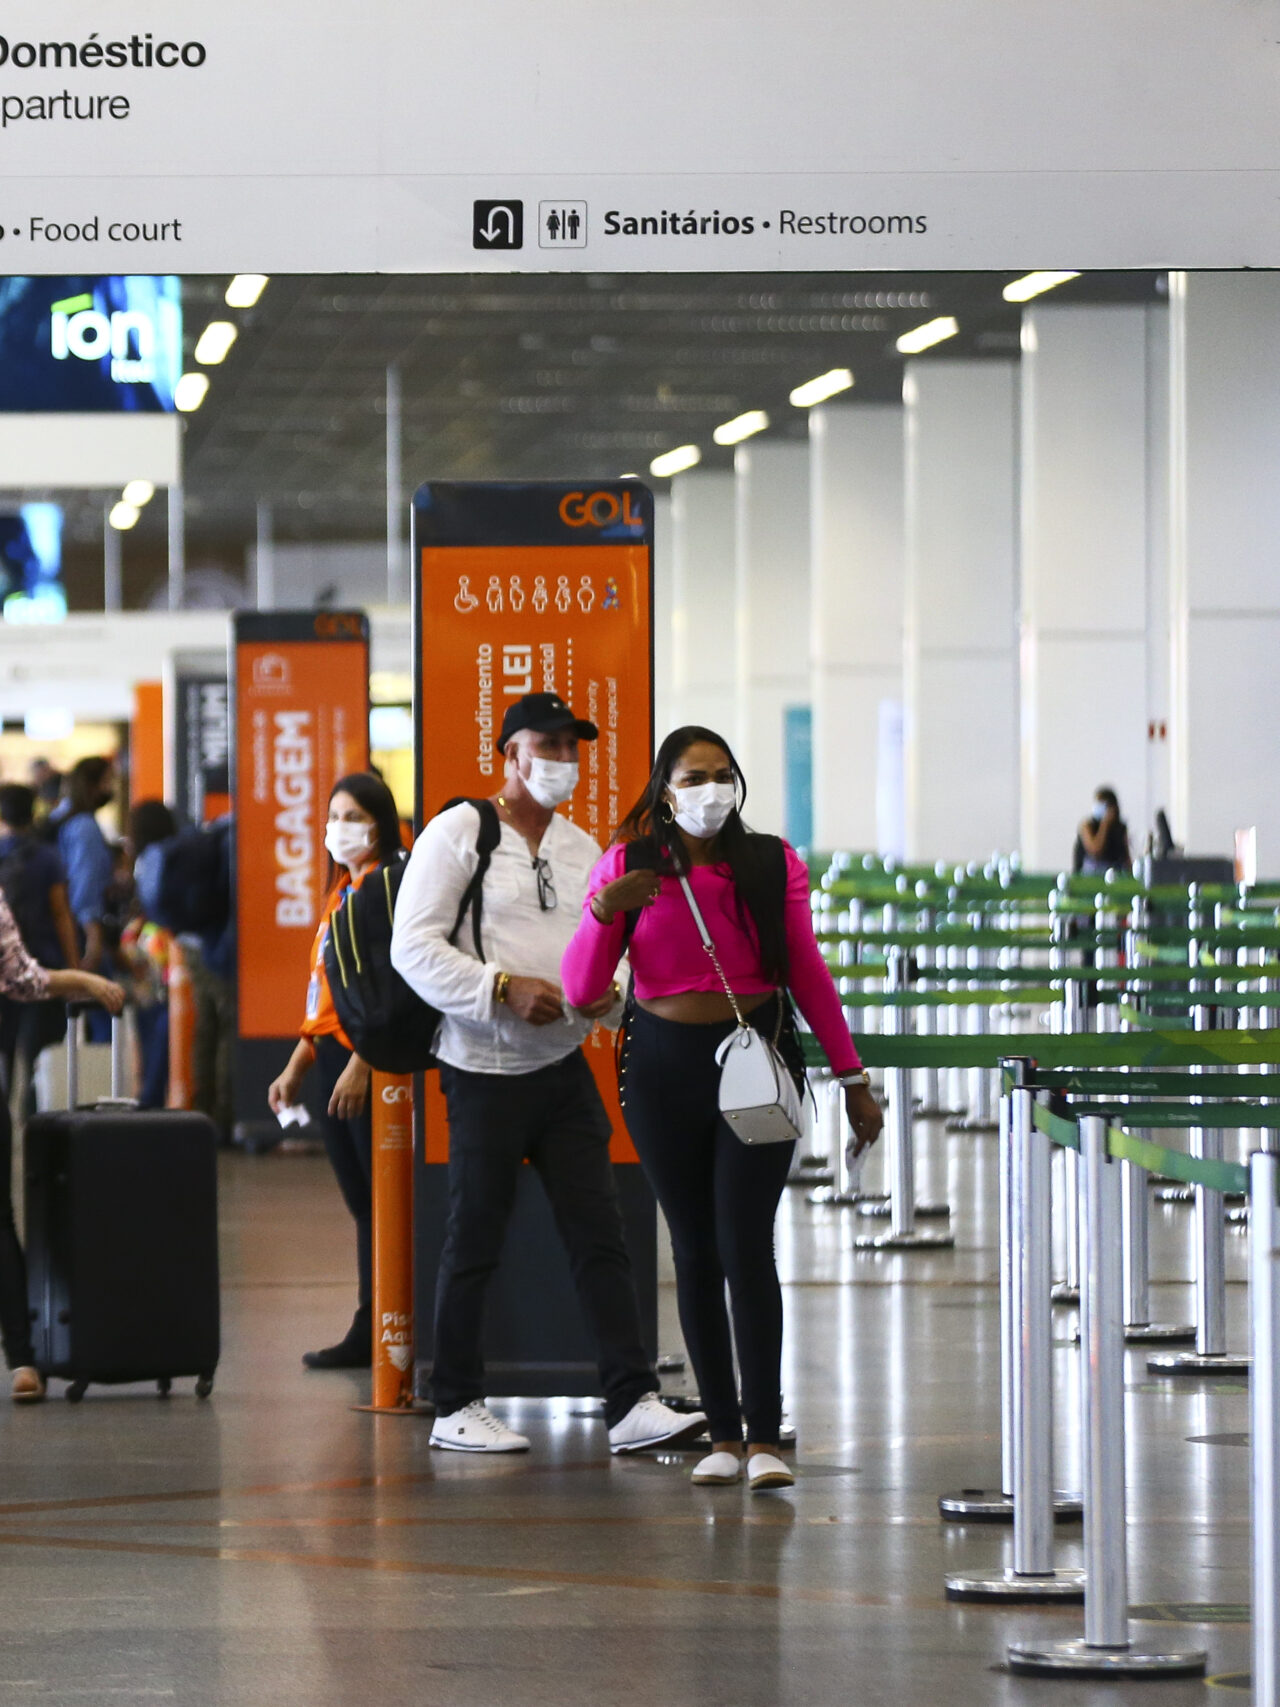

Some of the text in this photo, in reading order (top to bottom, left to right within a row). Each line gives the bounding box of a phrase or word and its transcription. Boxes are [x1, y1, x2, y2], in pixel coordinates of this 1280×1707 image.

[28, 217, 100, 242] Food
[107, 219, 183, 242] court
[604, 208, 928, 236] Sanitários Restrooms
[558, 491, 642, 527] GOL
[502, 644, 532, 694] LEI
[540, 643, 558, 694] pecial
[475, 643, 493, 776] atendimento
[588, 739, 600, 774] speci
[274, 711, 312, 927] BAGAGEM
[382, 1311, 410, 1328] Pis
